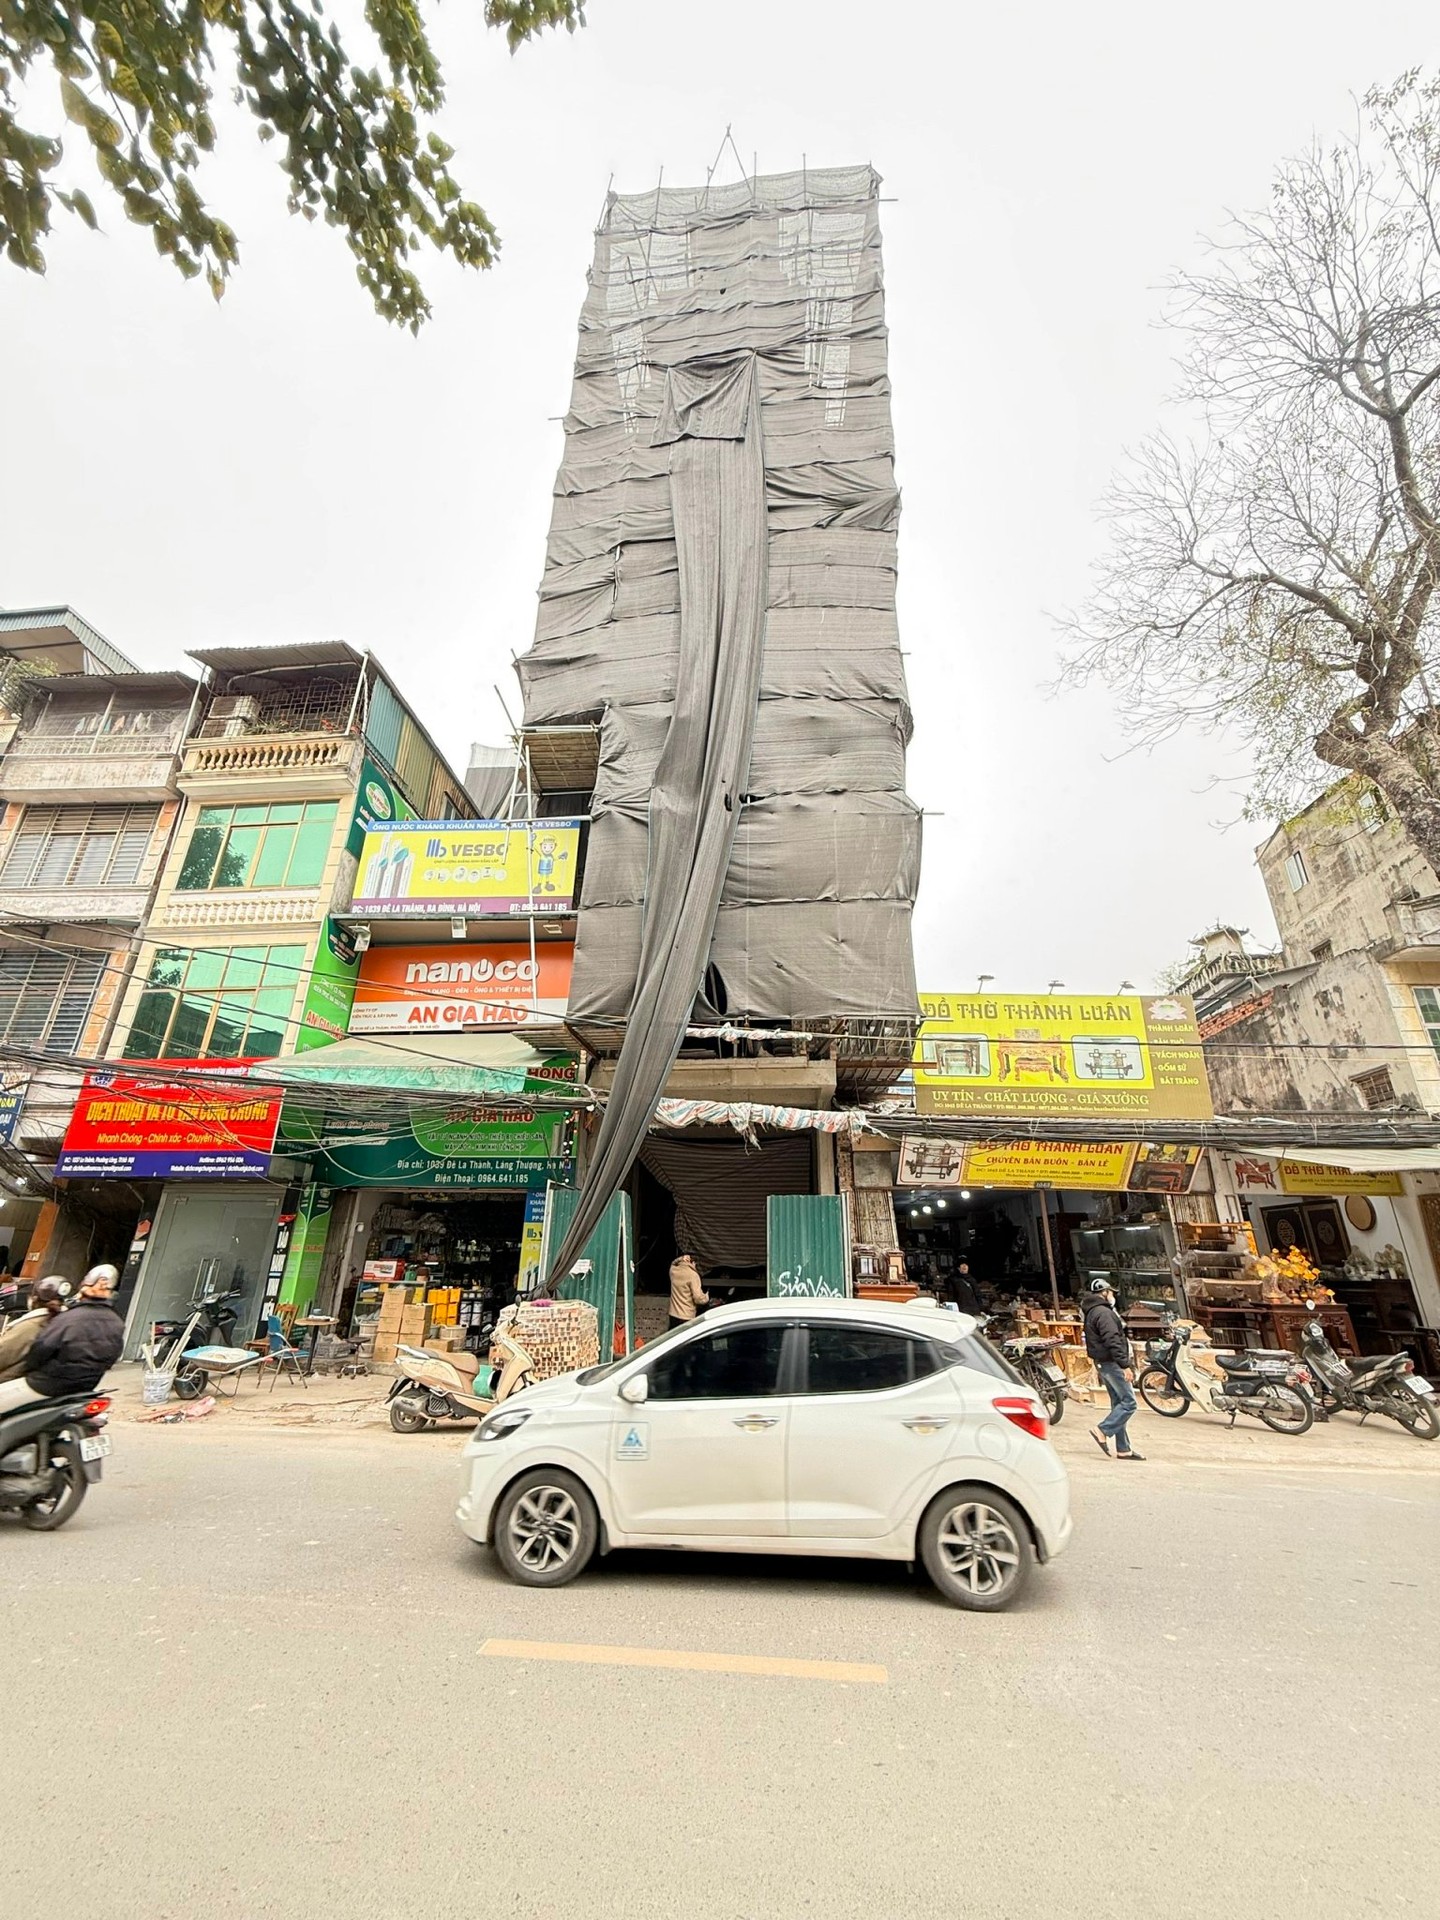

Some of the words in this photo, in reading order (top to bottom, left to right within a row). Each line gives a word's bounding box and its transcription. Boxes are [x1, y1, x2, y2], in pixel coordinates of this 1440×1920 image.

[391, 822, 414, 830] NƯỚC
[416, 821, 445, 830] KHÁNG
[446, 820, 475, 830] KHUẨN
[544, 820, 572, 828] VESBO
[451, 844, 507, 857] VESBO
[392, 904, 400, 913] LA
[405, 959, 540, 984] nanoco
[407, 1006, 439, 1023] AN
[442, 1005, 478, 1022] GIA
[482, 1000, 528, 1021] HẢO
[923, 997, 951, 1018] ĐỒ
[956, 1000, 998, 1019] THỜ
[1003, 1000, 1073, 1020] THÀNH
[1080, 1001, 1132, 1021] LUÂN
[1147, 1023, 1173, 1032] THÀNH
[1157, 1062, 1176, 1072] GỐM
[1174, 1075, 1199, 1085] TRÀNG
[932, 1090, 949, 1101] UY
[951, 1088, 974, 1101] TÍN
[984, 1089, 1019, 1102] CHẤT
[1022, 1091, 1067, 1105] LƯỢNG
[1077, 1091, 1101, 1104] GIÁ
[1101, 1090, 1150, 1105] XƯỞNG
[86, 1101, 115, 1126] DỊCH
[97, 1133, 120, 1144] Nhanh
[120, 1132, 143, 1146] Chóng
[148, 1132, 168, 1144] Chính
[397, 1160, 409, 1170] Địa
[426, 1161, 444, 1169] 1039
[458, 1160, 467, 1169] La
[1043, 1157, 1069, 1166] BUÔN
[434, 1173, 452, 1184] Điện
[454, 1173, 476, 1184] Thoại:
[477, 1174, 529, 1183] 0964.641.185
